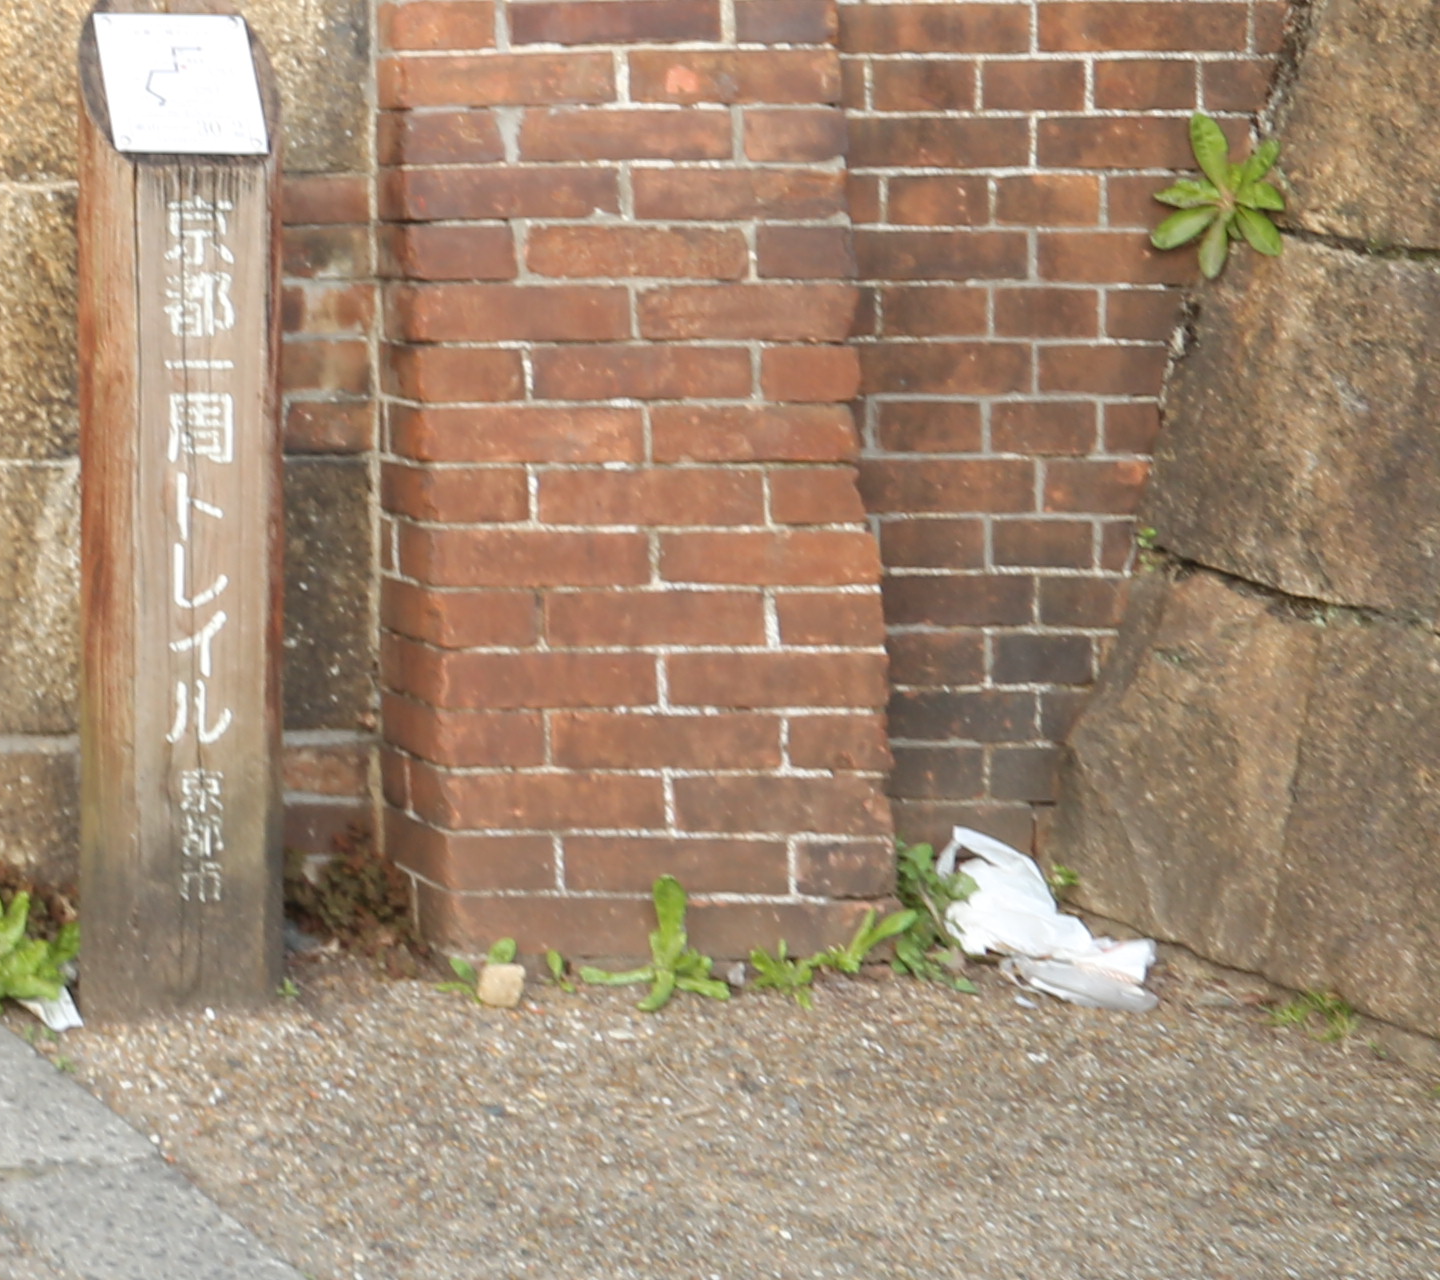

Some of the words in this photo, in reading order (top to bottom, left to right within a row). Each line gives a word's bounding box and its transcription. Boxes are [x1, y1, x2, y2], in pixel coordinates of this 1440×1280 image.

[164, 195, 235, 743] 京都一周トレイル
[180, 768, 224, 902] 京都市
